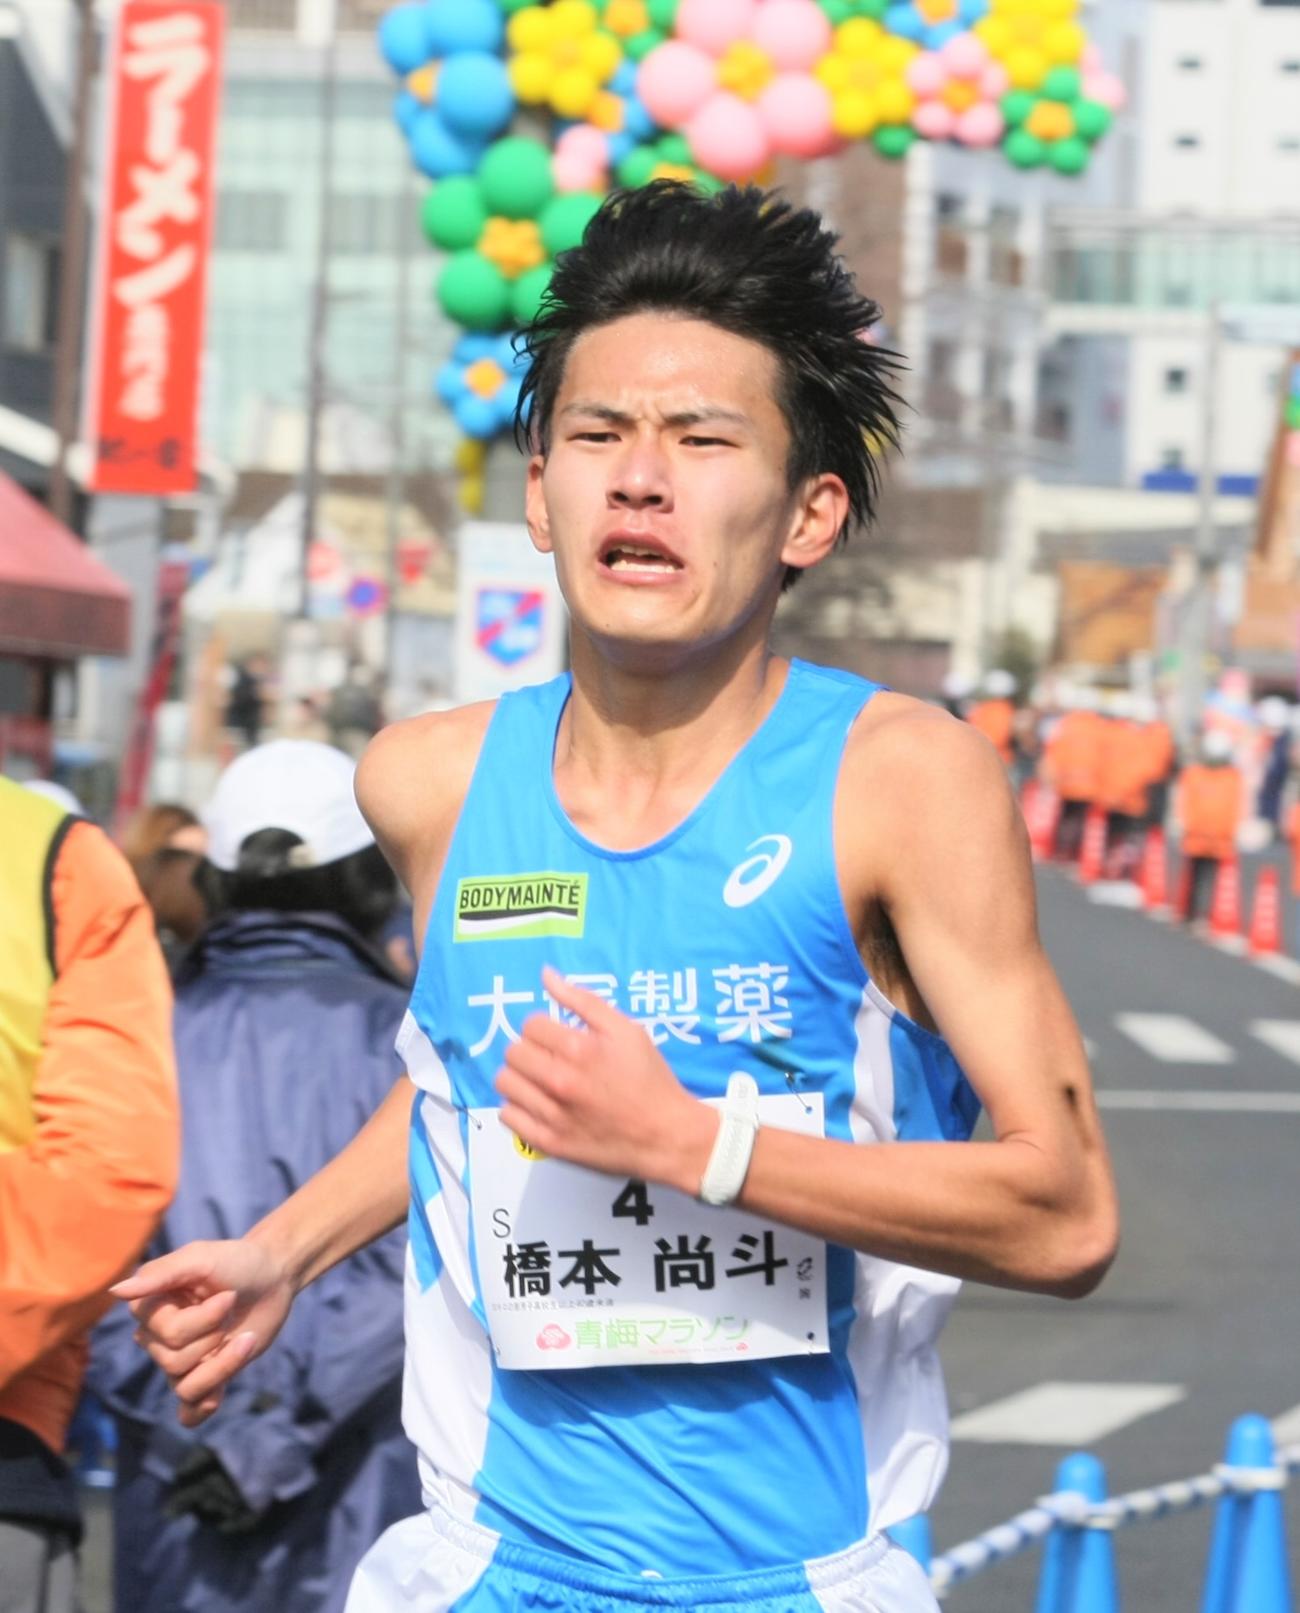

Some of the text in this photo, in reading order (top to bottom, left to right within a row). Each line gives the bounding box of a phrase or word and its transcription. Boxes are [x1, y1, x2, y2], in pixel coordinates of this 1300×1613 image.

[112, 13, 210, 308] ラーメン
[492, 1208, 511, 1239] S
[611, 1178, 655, 1226] 4
[503, 1231, 789, 1298] 橋本 尚斗
[574, 1316, 749, 1350] 青梅マラソン
